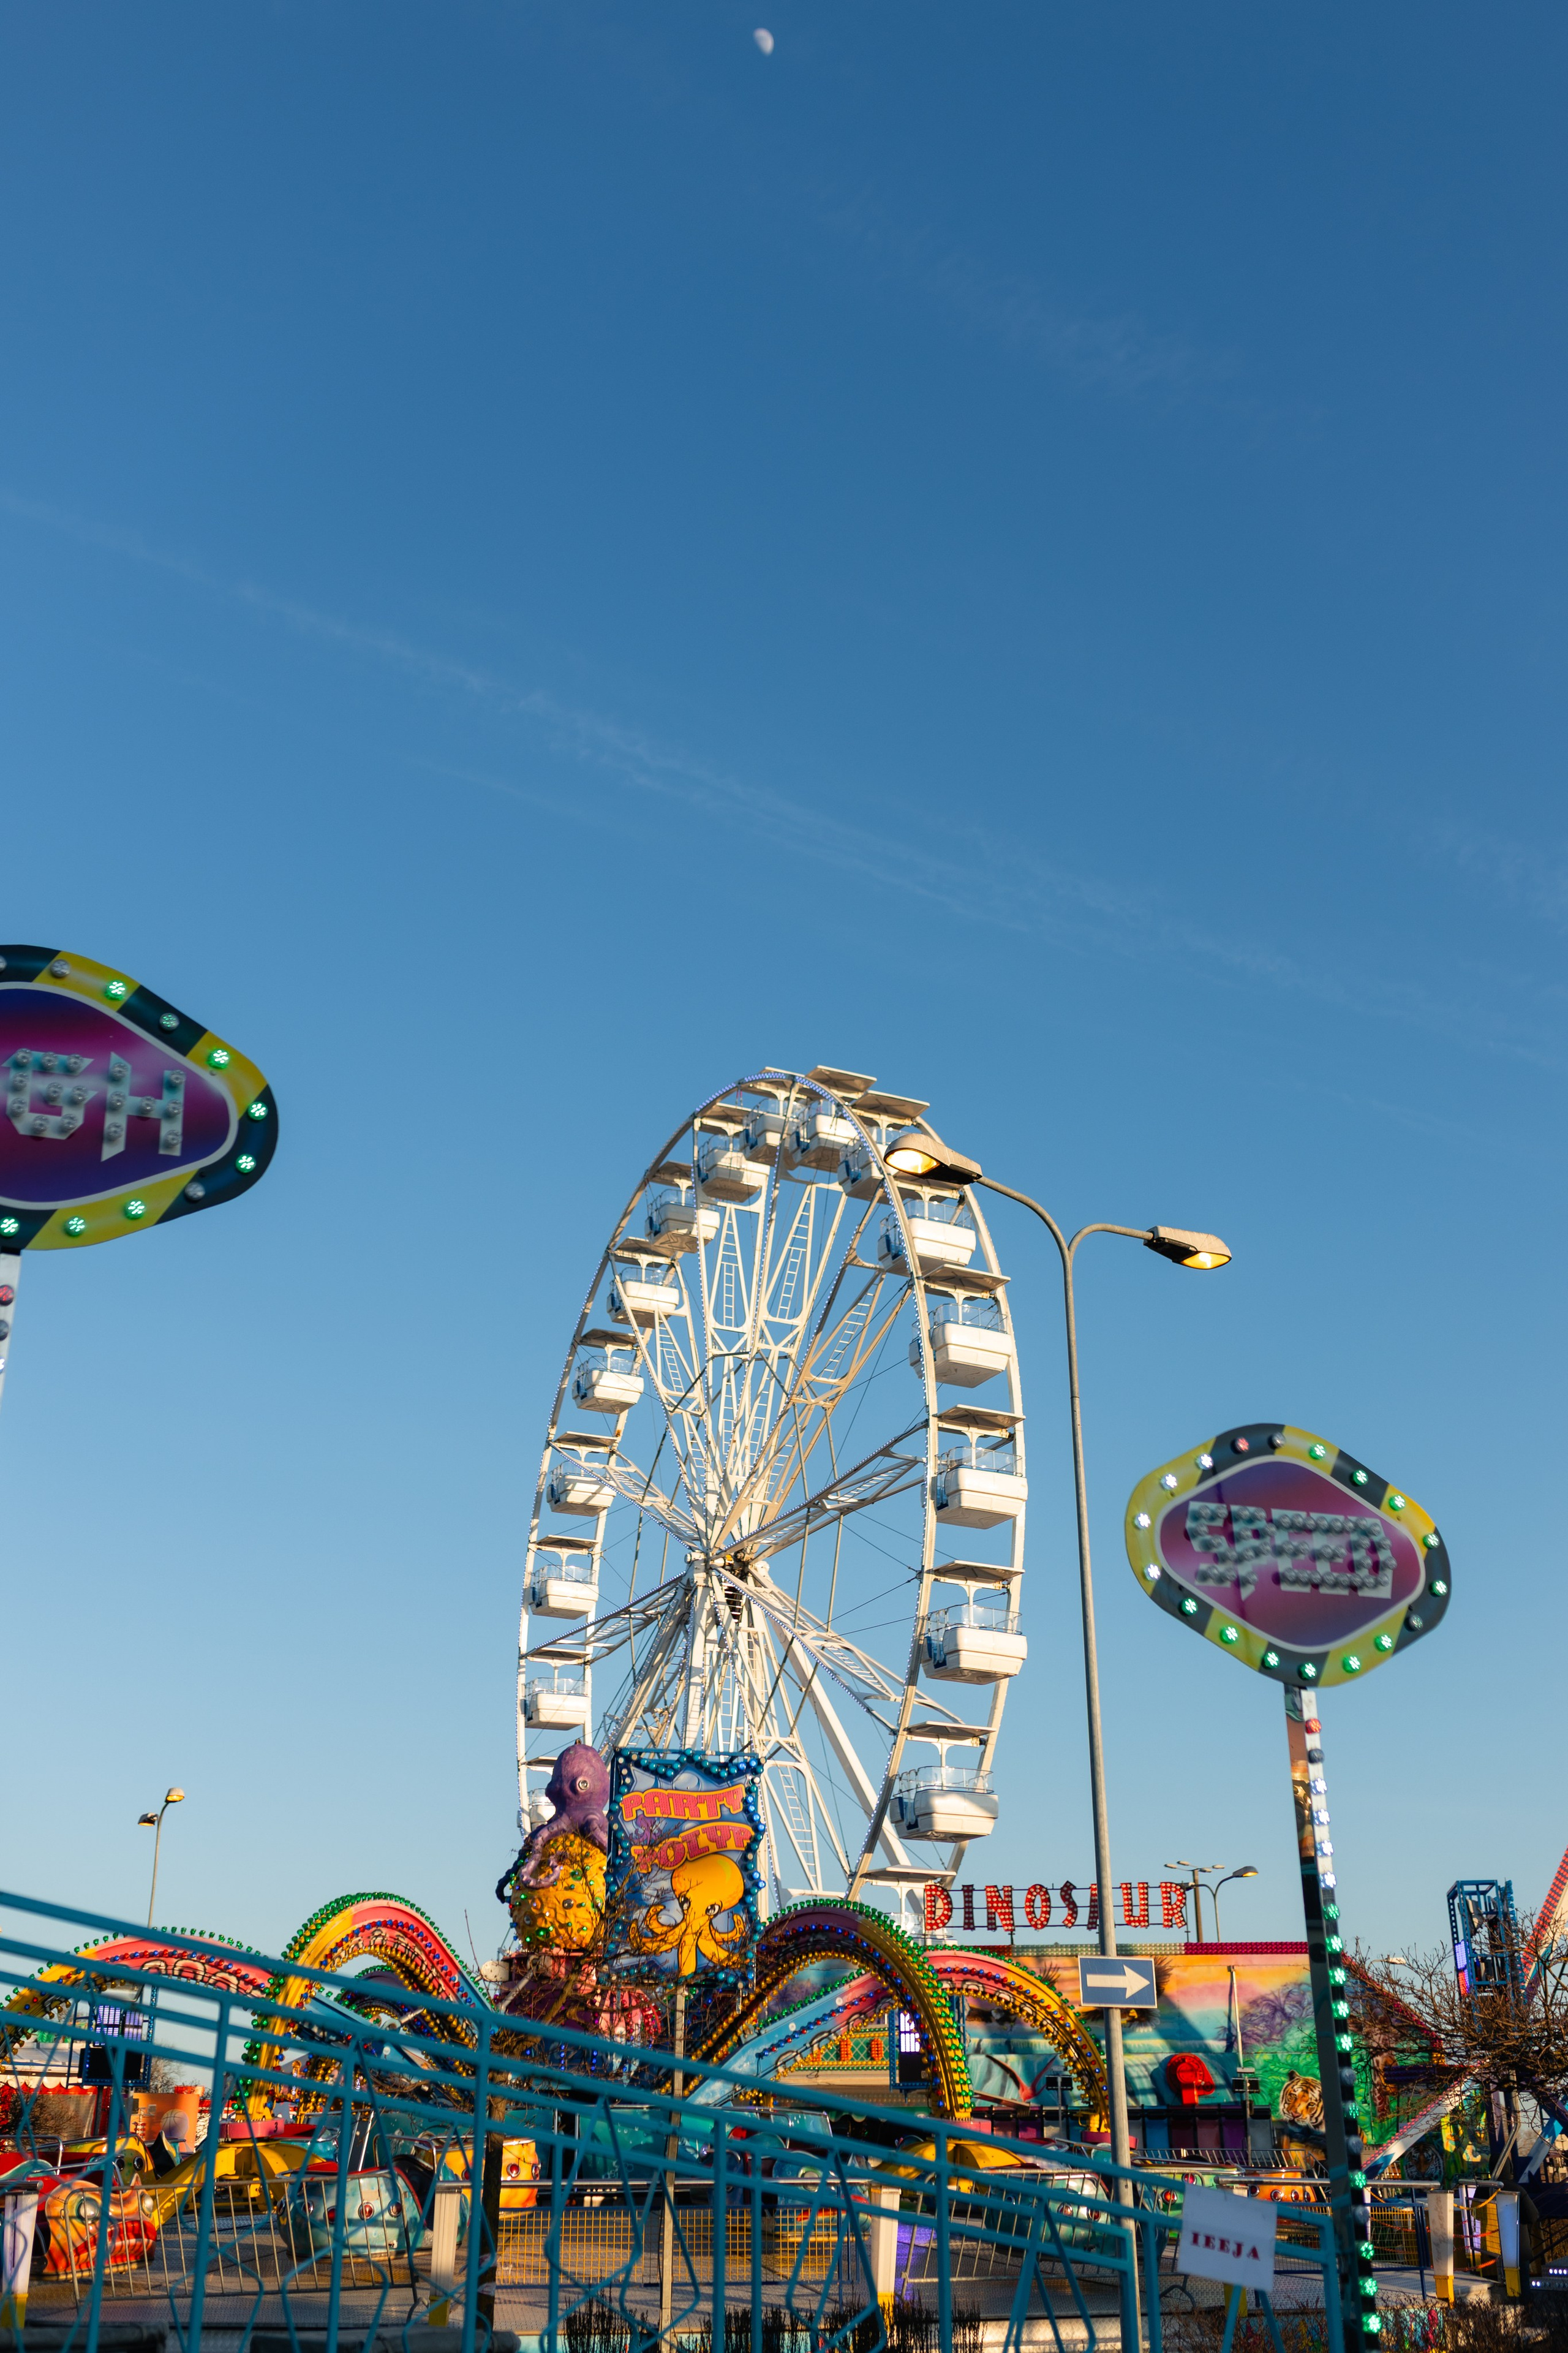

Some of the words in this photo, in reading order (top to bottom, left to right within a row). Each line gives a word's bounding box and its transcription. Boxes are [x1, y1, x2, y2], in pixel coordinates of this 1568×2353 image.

[1187, 1501, 1396, 1600] SPEED
[622, 1786, 744, 1818] PARTY
[633, 1825, 753, 1871] POLYP
[1191, 2232, 1261, 2261] IEEJA
